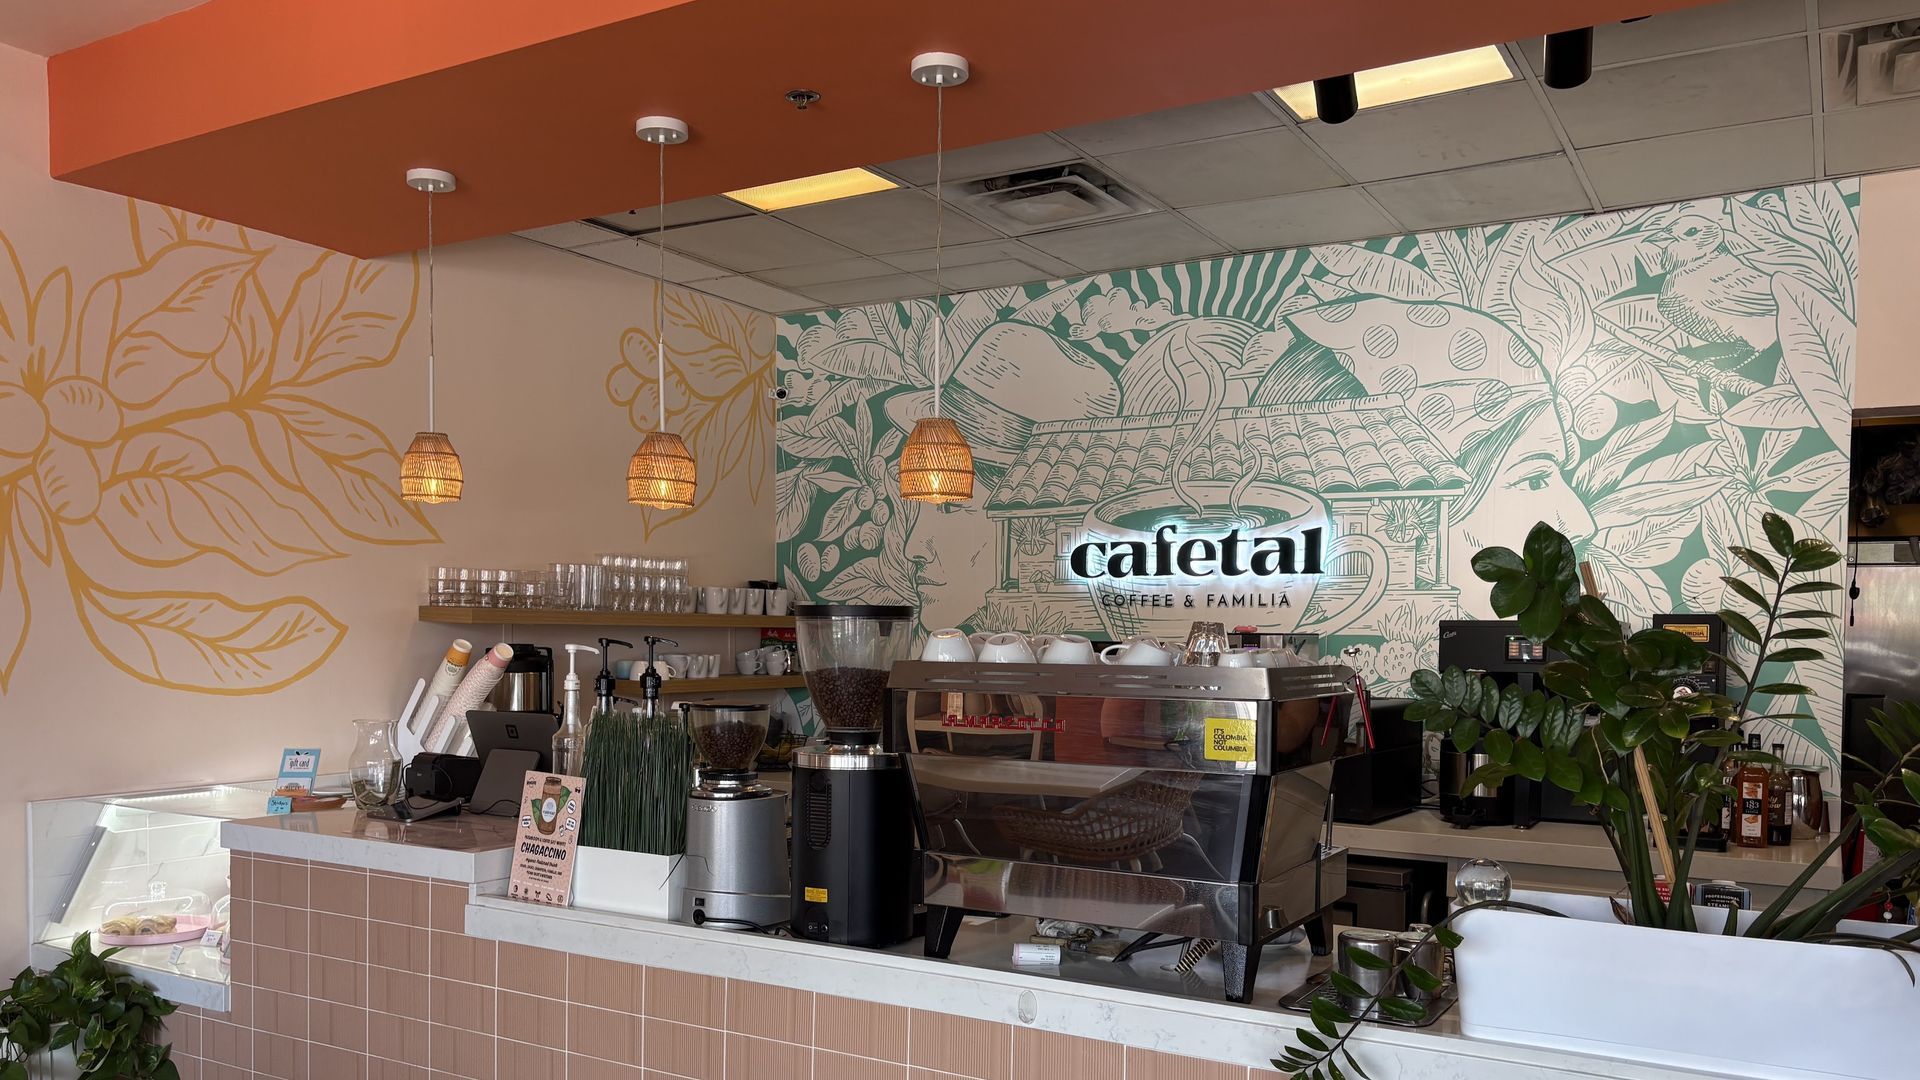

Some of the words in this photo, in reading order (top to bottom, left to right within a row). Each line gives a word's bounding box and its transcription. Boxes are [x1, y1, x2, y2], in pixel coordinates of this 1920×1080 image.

[1070, 525, 1324, 578] cafetal
[1102, 594, 1174, 607] COFFEE
[1184, 595, 1193, 608] &
[521, 841, 567, 860] CHAGACCINO
[1705, 894, 1741, 903] PROFESSIONAL
